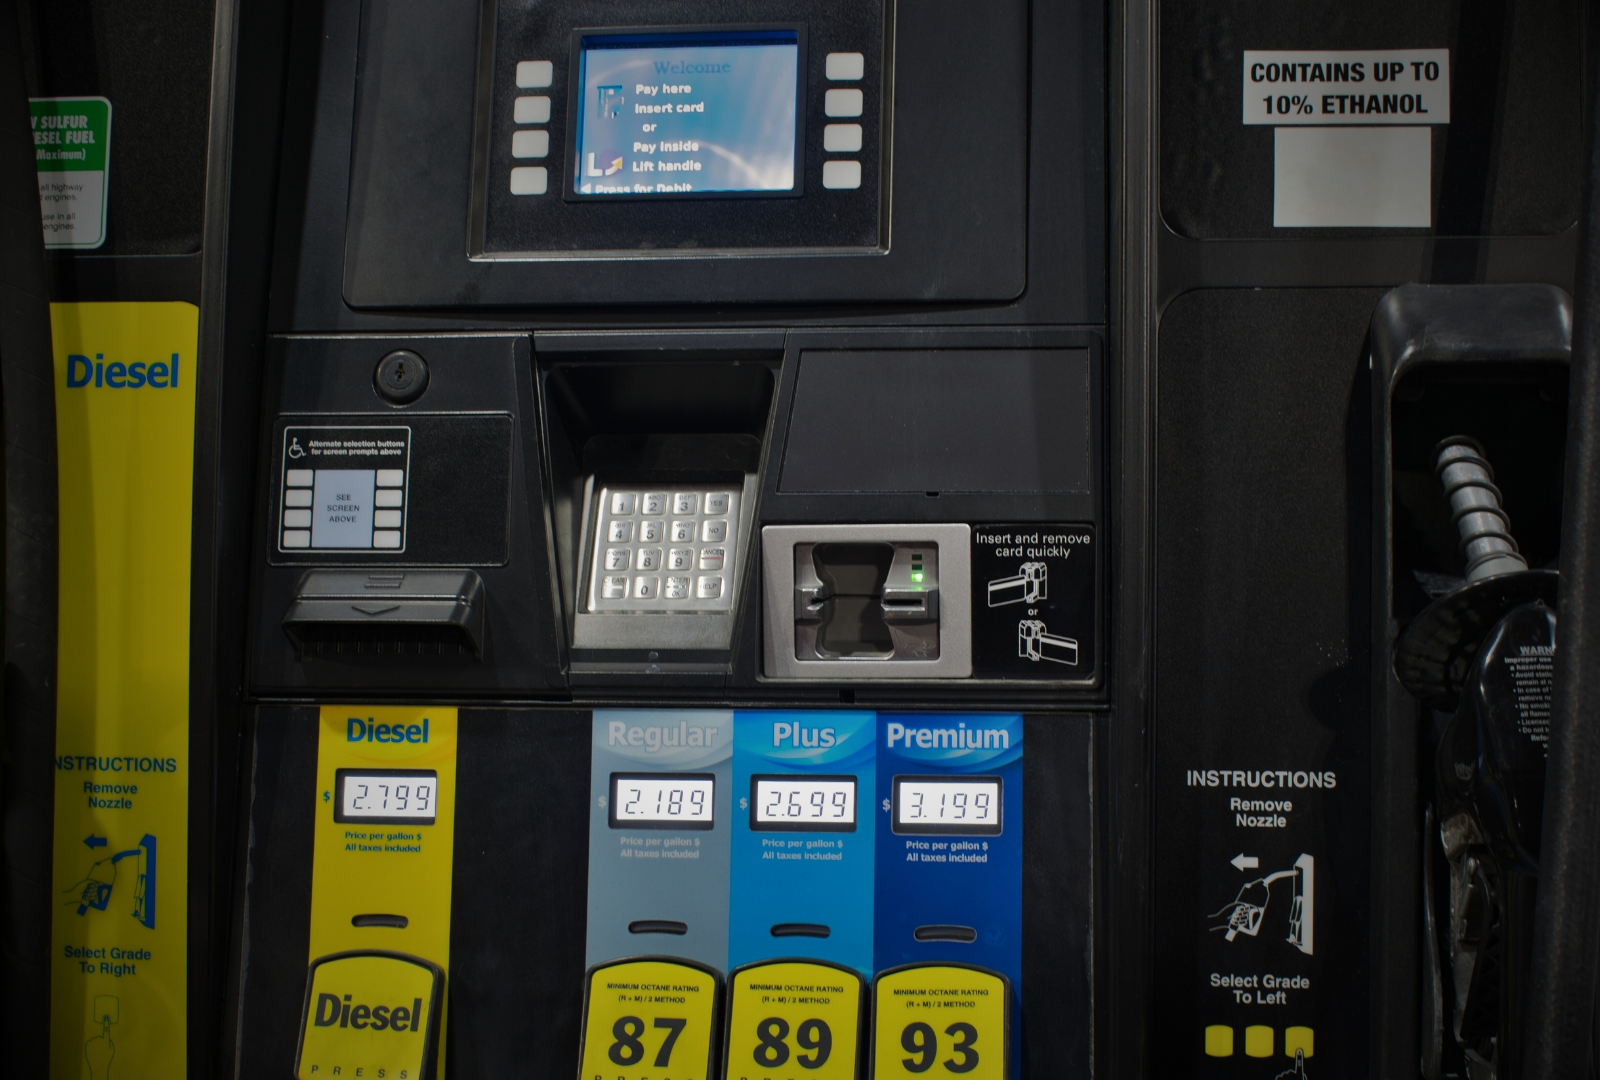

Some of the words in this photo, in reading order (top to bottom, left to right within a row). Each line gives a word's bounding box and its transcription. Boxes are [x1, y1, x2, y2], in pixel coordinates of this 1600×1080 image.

[654, 61, 731, 75] Welcome
[1251, 63, 1365, 82] CONTAINS
[1374, 62, 1404, 82] UP
[1411, 61, 1439, 81] TO
[636, 84, 658, 96] Pay
[663, 83, 692, 94] here
[635, 103, 673, 114] Insert
[677, 102, 704, 113] card
[1263, 95, 1313, 114] 10%
[1322, 94, 1428, 114] ETHANOL
[41, 115, 88, 129] SULFUR
[643, 123, 657, 132] or
[65, 130, 95, 144] FUEL
[633, 142, 656, 154] Pay
[660, 140, 699, 152] Inside
[633, 161, 654, 172] Lift
[658, 160, 701, 171] handle
[51, 183, 83, 194] highway
[595, 185, 630, 194] Press
[634, 184, 653, 193] for
[57, 212, 64, 220] in
[67, 353, 179, 388] Diesel
[309, 440, 341, 448] Alternate
[349, 449, 378, 457] prompts
[619, 502, 624, 511] 1
[650, 503, 657, 511] 2
[680, 502, 688, 511] 3
[615, 530, 622, 539] 4
[646, 530, 654, 539] 5
[678, 530, 685, 539] 6
[976, 533, 1011, 544] Insert
[1015, 533, 1038, 544] and
[1043, 534, 1090, 544] remove
[996, 545, 1022, 557] card
[1027, 546, 1070, 559] quickly
[613, 558, 620, 567] 7
[644, 558, 651, 566] 8
[675, 558, 683, 566] 9
[641, 586, 648, 595] 0
[1504, 657, 1537, 665] Improper
[347, 718, 429, 743] Diesel
[608, 721, 717, 752] Regular
[773, 722, 836, 748] Plus
[887, 722, 1009, 749] Premium
[1186, 770, 1336, 788] INSTRUCTIONS
[83, 782, 137, 794] Remove
[88, 797, 132, 809] Nozzle
[323, 790, 330, 803] $
[353, 785, 430, 810] 2.799
[598, 795, 606, 809] $
[625, 789, 704, 815] 2.189
[740, 796, 747, 810] $
[766, 792, 846, 817] 2.699
[883, 798, 890, 813] $
[910, 793, 989, 818] 3.199
[1230, 798, 1292, 811] Remove
[1236, 814, 1286, 827] Nozzle
[370, 833, 384, 841] per
[387, 833, 413, 841] gallon
[620, 837, 643, 845] Price
[647, 838, 661, 848] per
[664, 838, 692, 848] gallon
[694, 838, 700, 847] $
[762, 839, 785, 848] Price
[789, 840, 803, 850] per
[806, 840, 834, 850] gallon
[837, 840, 843, 849] $
[906, 841, 929, 849] Price
[932, 842, 948, 851] per
[951, 841, 979, 851] gallon
[982, 842, 988, 850] $
[620, 849, 632, 858] All
[634, 850, 658, 858] taxes
[661, 850, 699, 858] included
[762, 851, 774, 860] All
[777, 852, 801, 860] taxes
[804, 852, 842, 860] included
[906, 853, 918, 861] All
[921, 854, 946, 862] taxes
[949, 854, 987, 863] included
[65, 946, 106, 959] Select
[110, 948, 151, 961] Grade
[79, 962, 95, 974] To
[100, 962, 136, 977] Right
[607, 983, 639, 991] MINIMUM
[1210, 973, 1258, 987] Select
[1262, 974, 1310, 989] Grade
[750, 984, 782, 992] MINIMUM
[1233, 990, 1252, 1004] To
[1257, 990, 1286, 1005] Left
[314, 993, 422, 1032] Diesel
[608, 1016, 687, 1068] 87
[753, 1017, 832, 1070] 89
[901, 1022, 979, 1073] 93
[311, 1065, 407, 1079] PRESS
